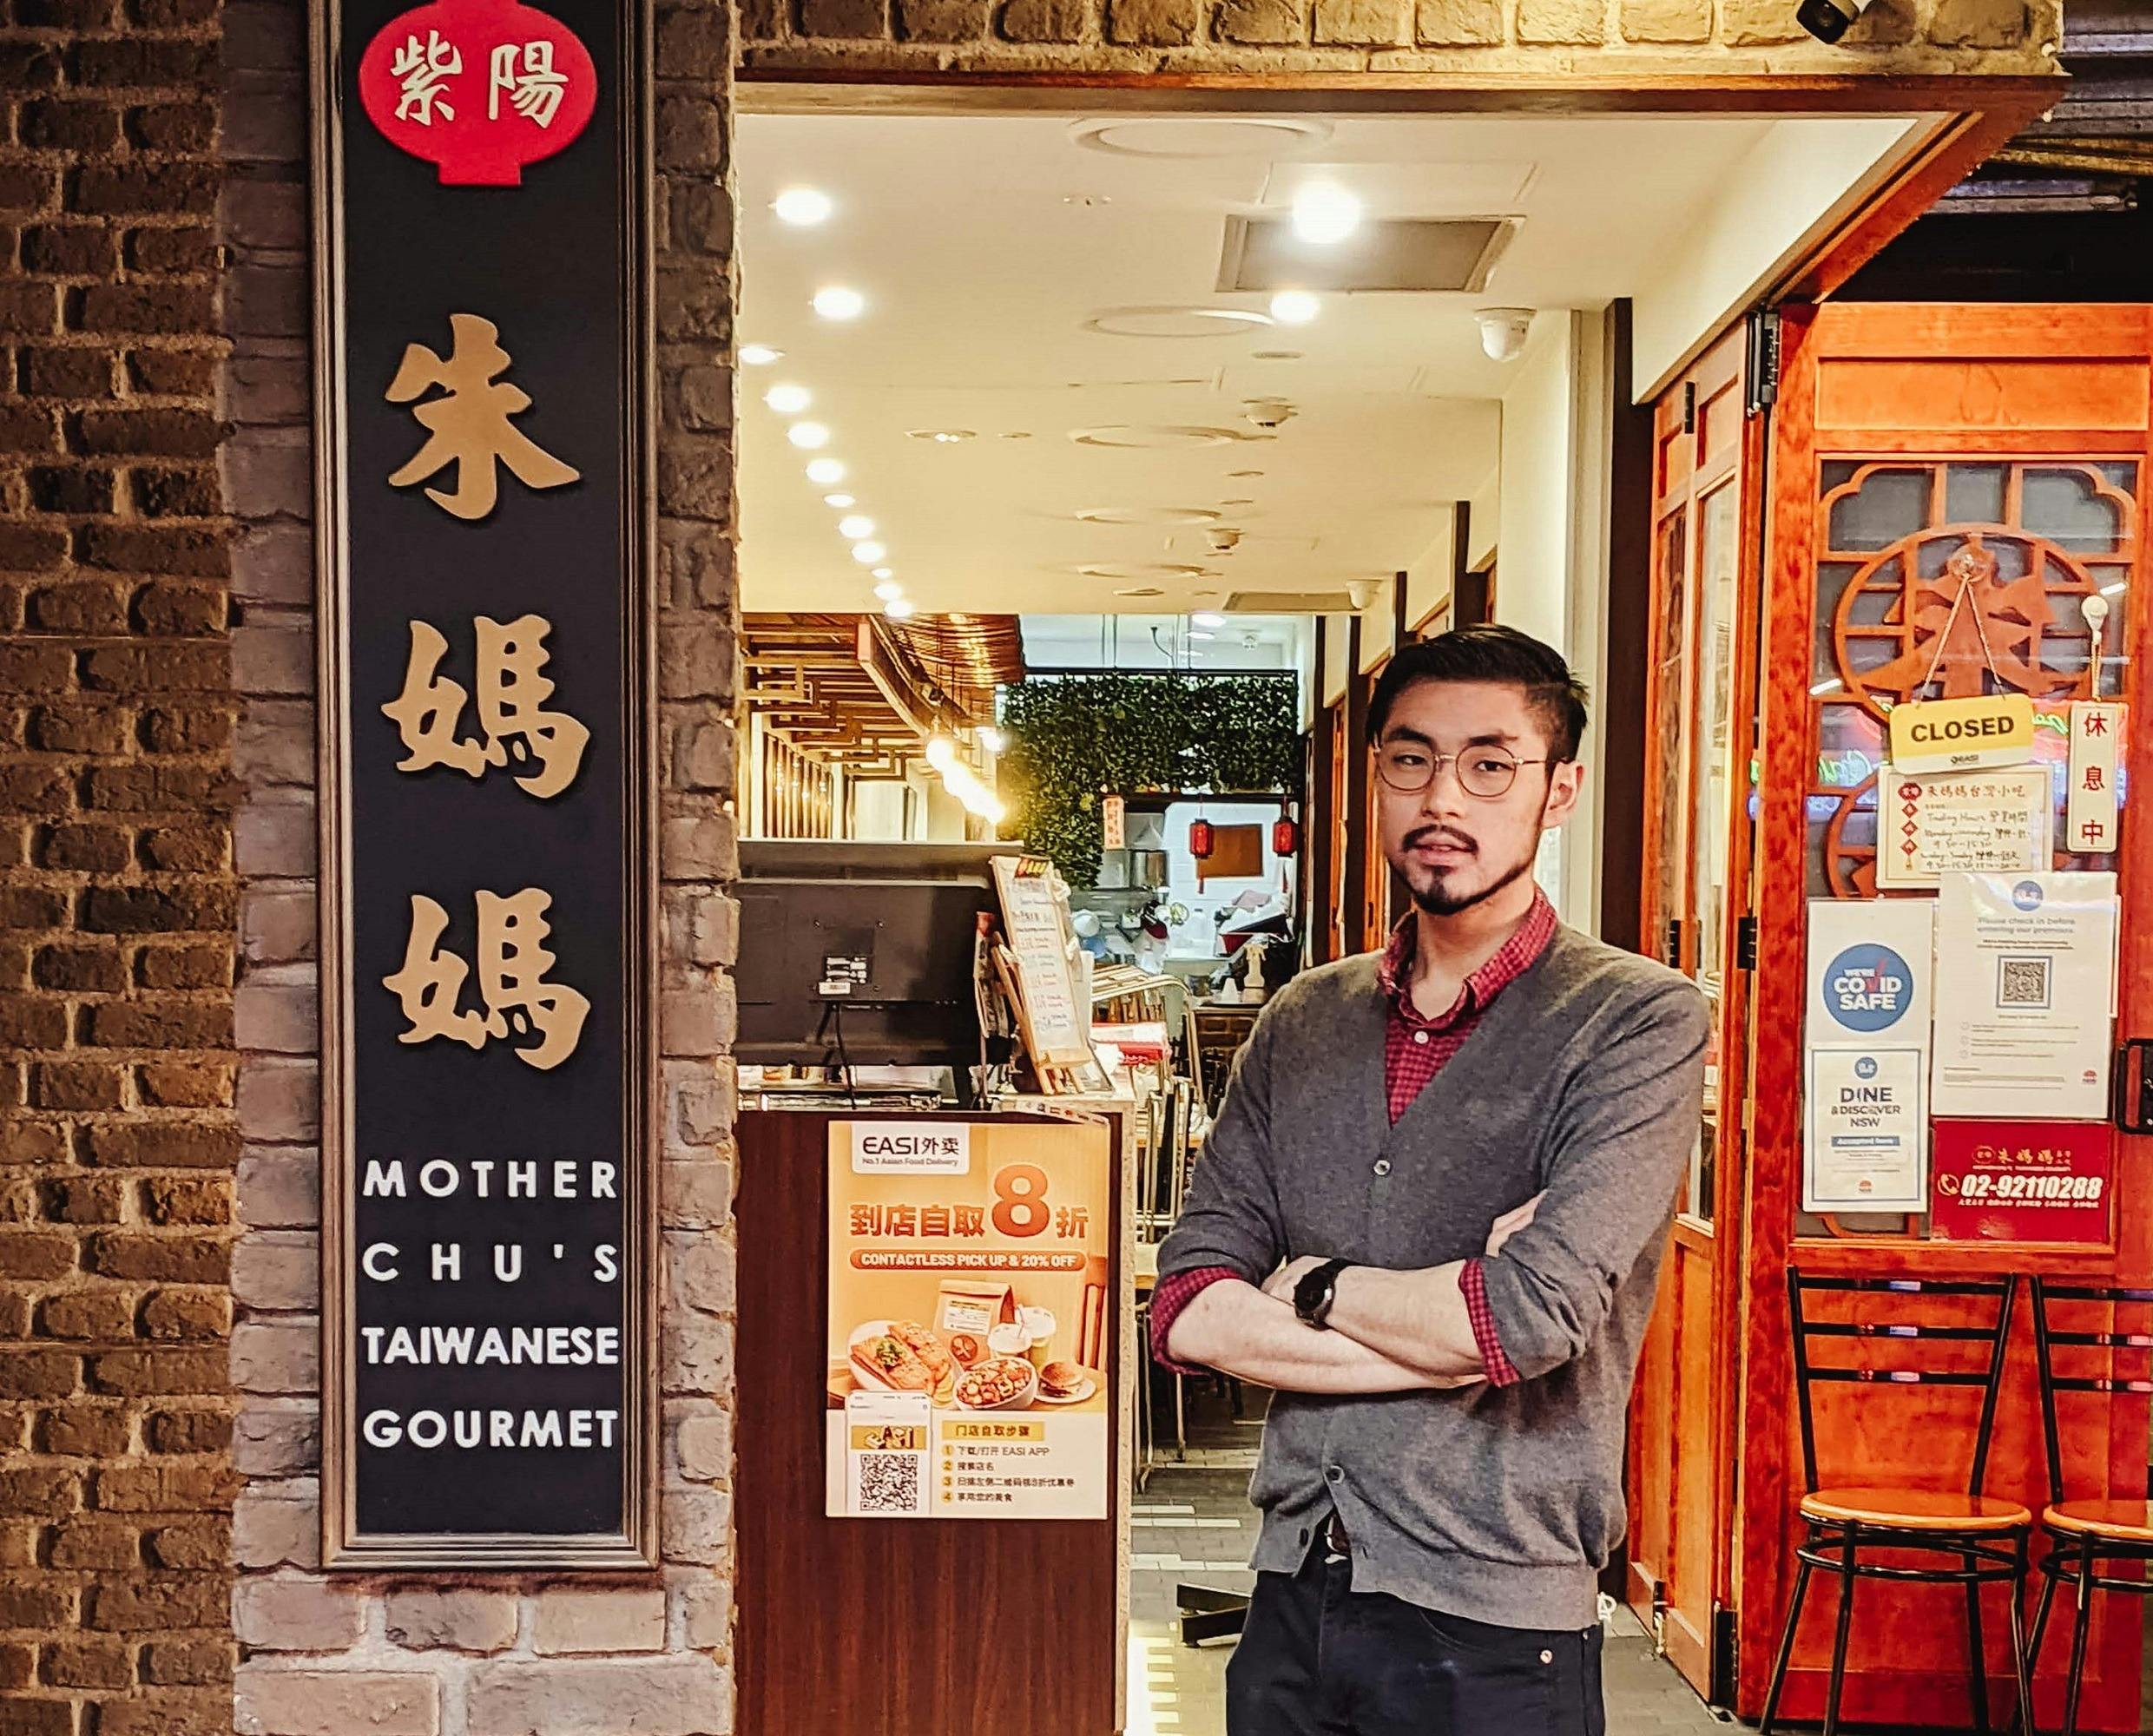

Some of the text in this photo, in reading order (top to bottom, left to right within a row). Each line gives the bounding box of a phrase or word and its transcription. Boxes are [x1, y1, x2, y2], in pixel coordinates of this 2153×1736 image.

[390, 30, 569, 128] 紫陽
[381, 313, 590, 1071] 朱媽媽
[1910, 715, 2015, 743] CLOSED
[2082, 712, 2107, 845] 休息中
[1834, 976, 1902, 994] COVID
[1840, 993, 1897, 1010] SAFE
[1840, 1088, 1893, 1102] DINE
[1840, 1105, 1901, 1115] DISCOVER
[1850, 1118, 1881, 1128] NSW
[362, 1159, 617, 1198] MOTHER
[1960, 1174, 2104, 1200] 02-92110288
[362, 1242, 617, 1282] CHU'S
[860, 1253, 956, 1266] CONTACTLESS
[957, 1254, 987, 1266] PICK
[989, 1255, 1007, 1266] UP
[1022, 1255, 1049, 1267] 20%
[1050, 1255, 1076, 1267] OFF
[361, 1327, 618, 1365] TAIWANESE
[363, 1409, 618, 1448] GOURMET
[1002, 1447, 1025, 1456] EASI
[1028, 1447, 1050, 1457] APP
